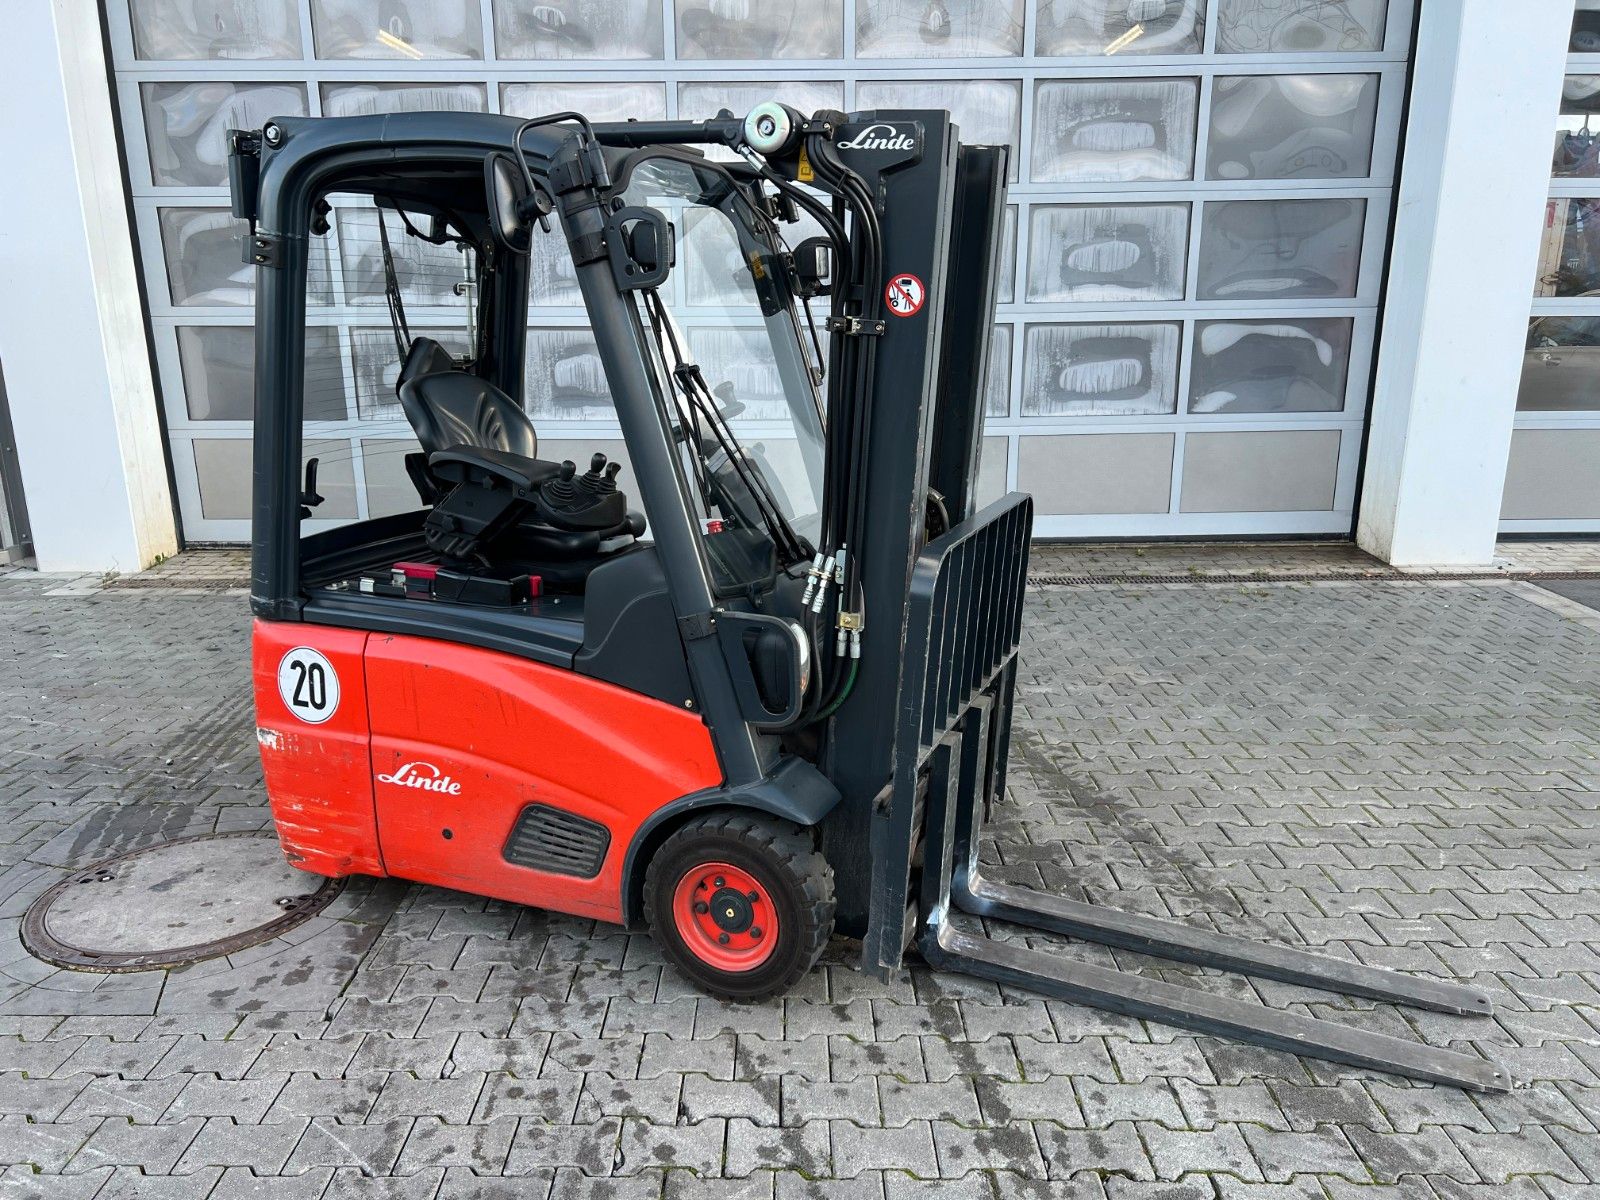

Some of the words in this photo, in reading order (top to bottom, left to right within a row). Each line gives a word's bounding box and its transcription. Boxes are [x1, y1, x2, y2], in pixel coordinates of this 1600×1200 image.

[837, 124, 914, 150] Linde
[290, 660, 326, 710] 20
[378, 761, 461, 795] Linde
